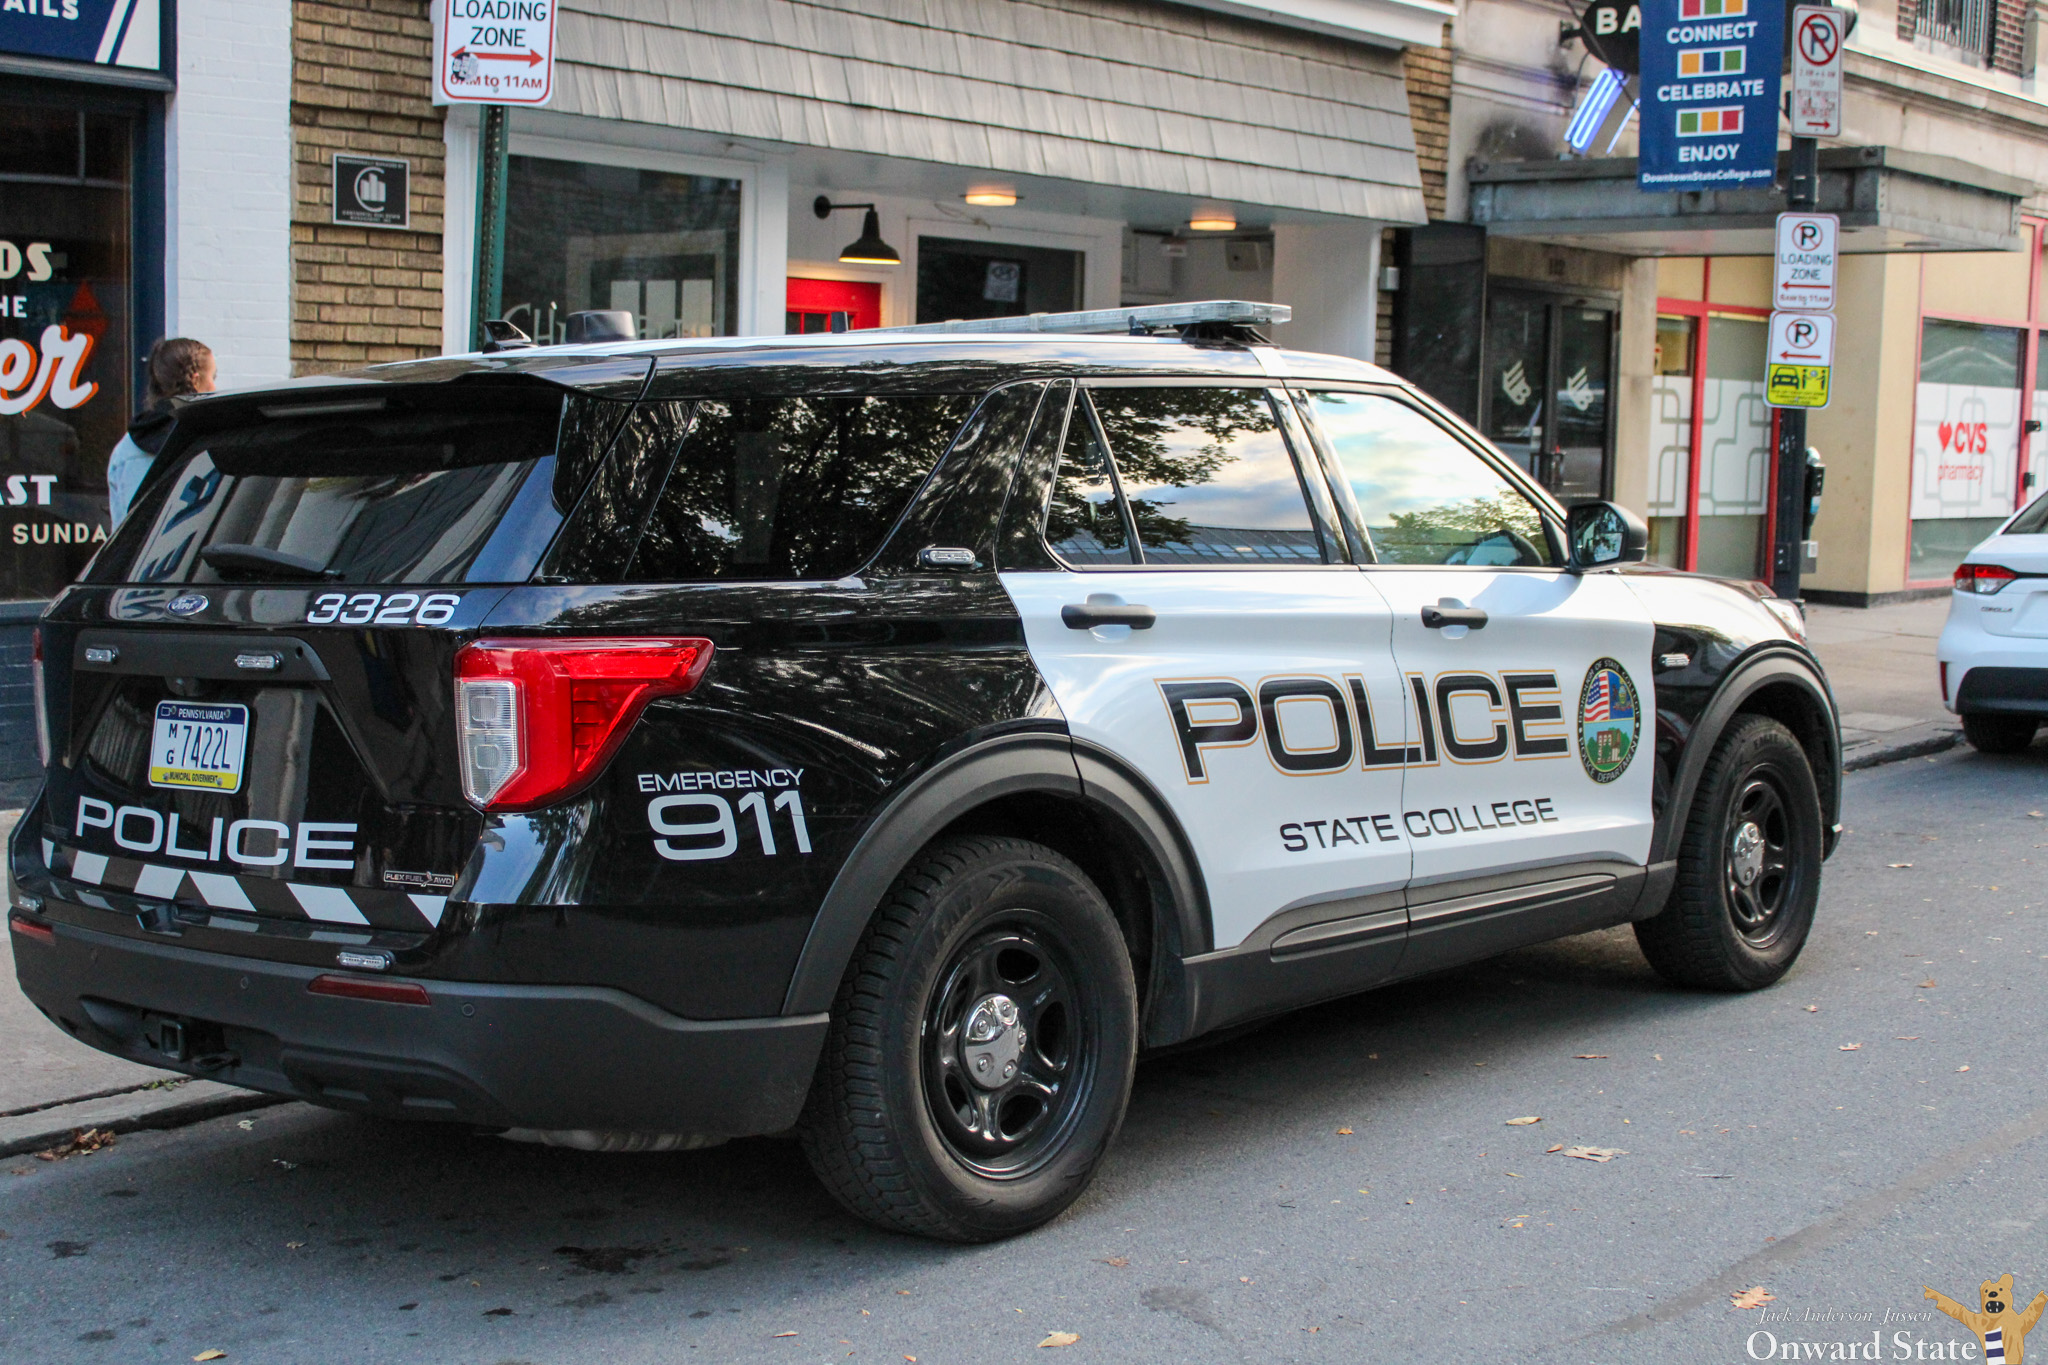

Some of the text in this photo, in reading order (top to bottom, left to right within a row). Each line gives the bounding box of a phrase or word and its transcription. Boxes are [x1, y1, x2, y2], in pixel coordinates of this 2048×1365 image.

[452, 0, 547, 21] LOADING
[1596, 4, 1641, 35] BA
[470, 26, 526, 47] ZONE
[1666, 21, 1758, 44] CONNECT
[450, 73, 542, 89] 6M to 11AM
[1657, 79, 1765, 102] CELEBRATE
[1678, 144, 1740, 163] ENJOY
[1642, 169, 1772, 184] DowntownStateCollege.com
[1780, 253, 1832, 266] LOADING
[1791, 268, 1821, 280] ZONE
[1954, 421, 1987, 454] CVS
[1937, 461, 1984, 487] pharmacy
[0, 475, 58, 505] ST
[306, 593, 461, 625] 3326
[178, 708, 224, 720] PENNSYLVANIA
[1154, 669, 1571, 785] POLICE
[181, 725, 231, 769] 7422L
[169, 771, 218, 784] MUNICIPAL GOVERNMENT
[637, 768, 804, 793] EMERGENCY
[75, 795, 358, 869] POLICE
[647, 790, 813, 861] 911
[1280, 797, 1558, 852] STATE COLLEGE
[386, 873, 405, 881] FLEX
